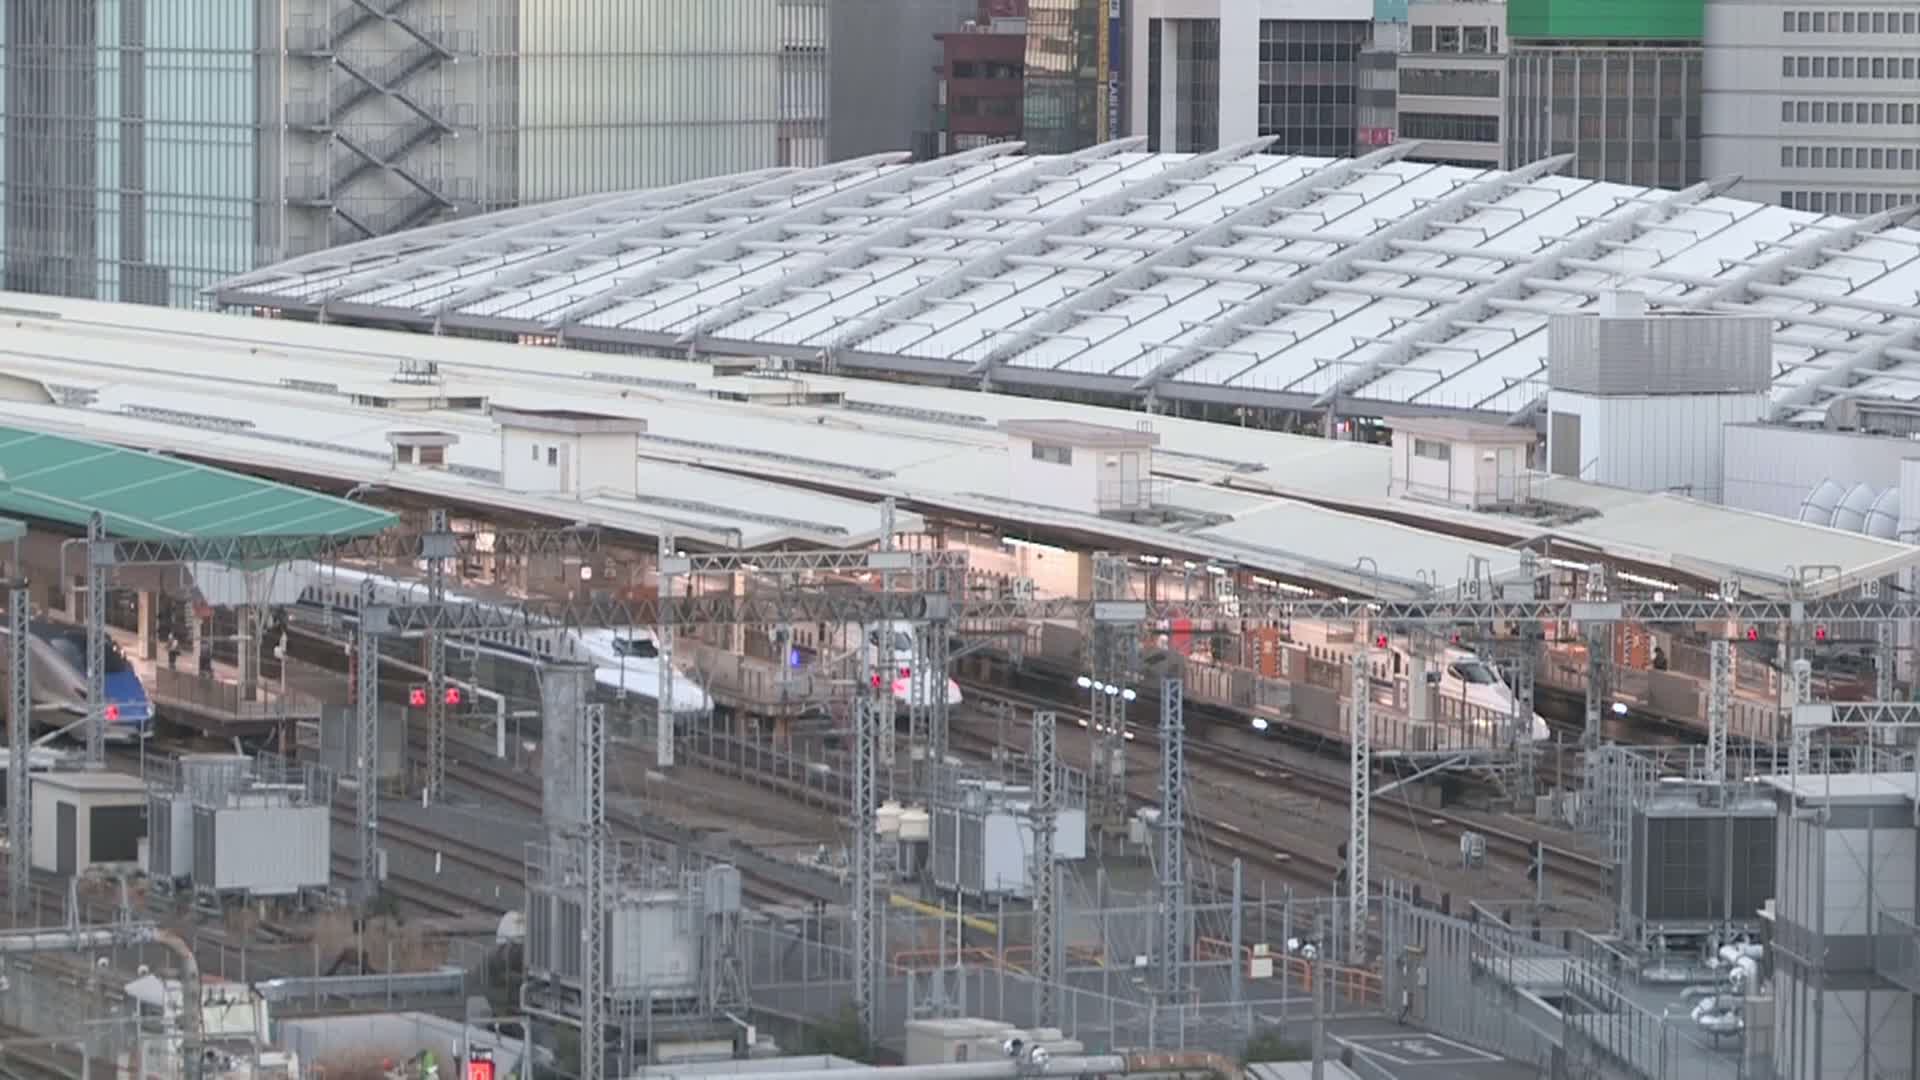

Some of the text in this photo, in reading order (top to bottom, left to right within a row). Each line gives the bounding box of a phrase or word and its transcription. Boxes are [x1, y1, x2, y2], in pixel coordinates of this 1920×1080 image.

[1015, 580, 1031, 594] 14
[1217, 580, 1232, 595] 15
[1462, 580, 1477, 594] 16
[1723, 580, 1738, 596] 17
[1863, 580, 1878, 595] 18
